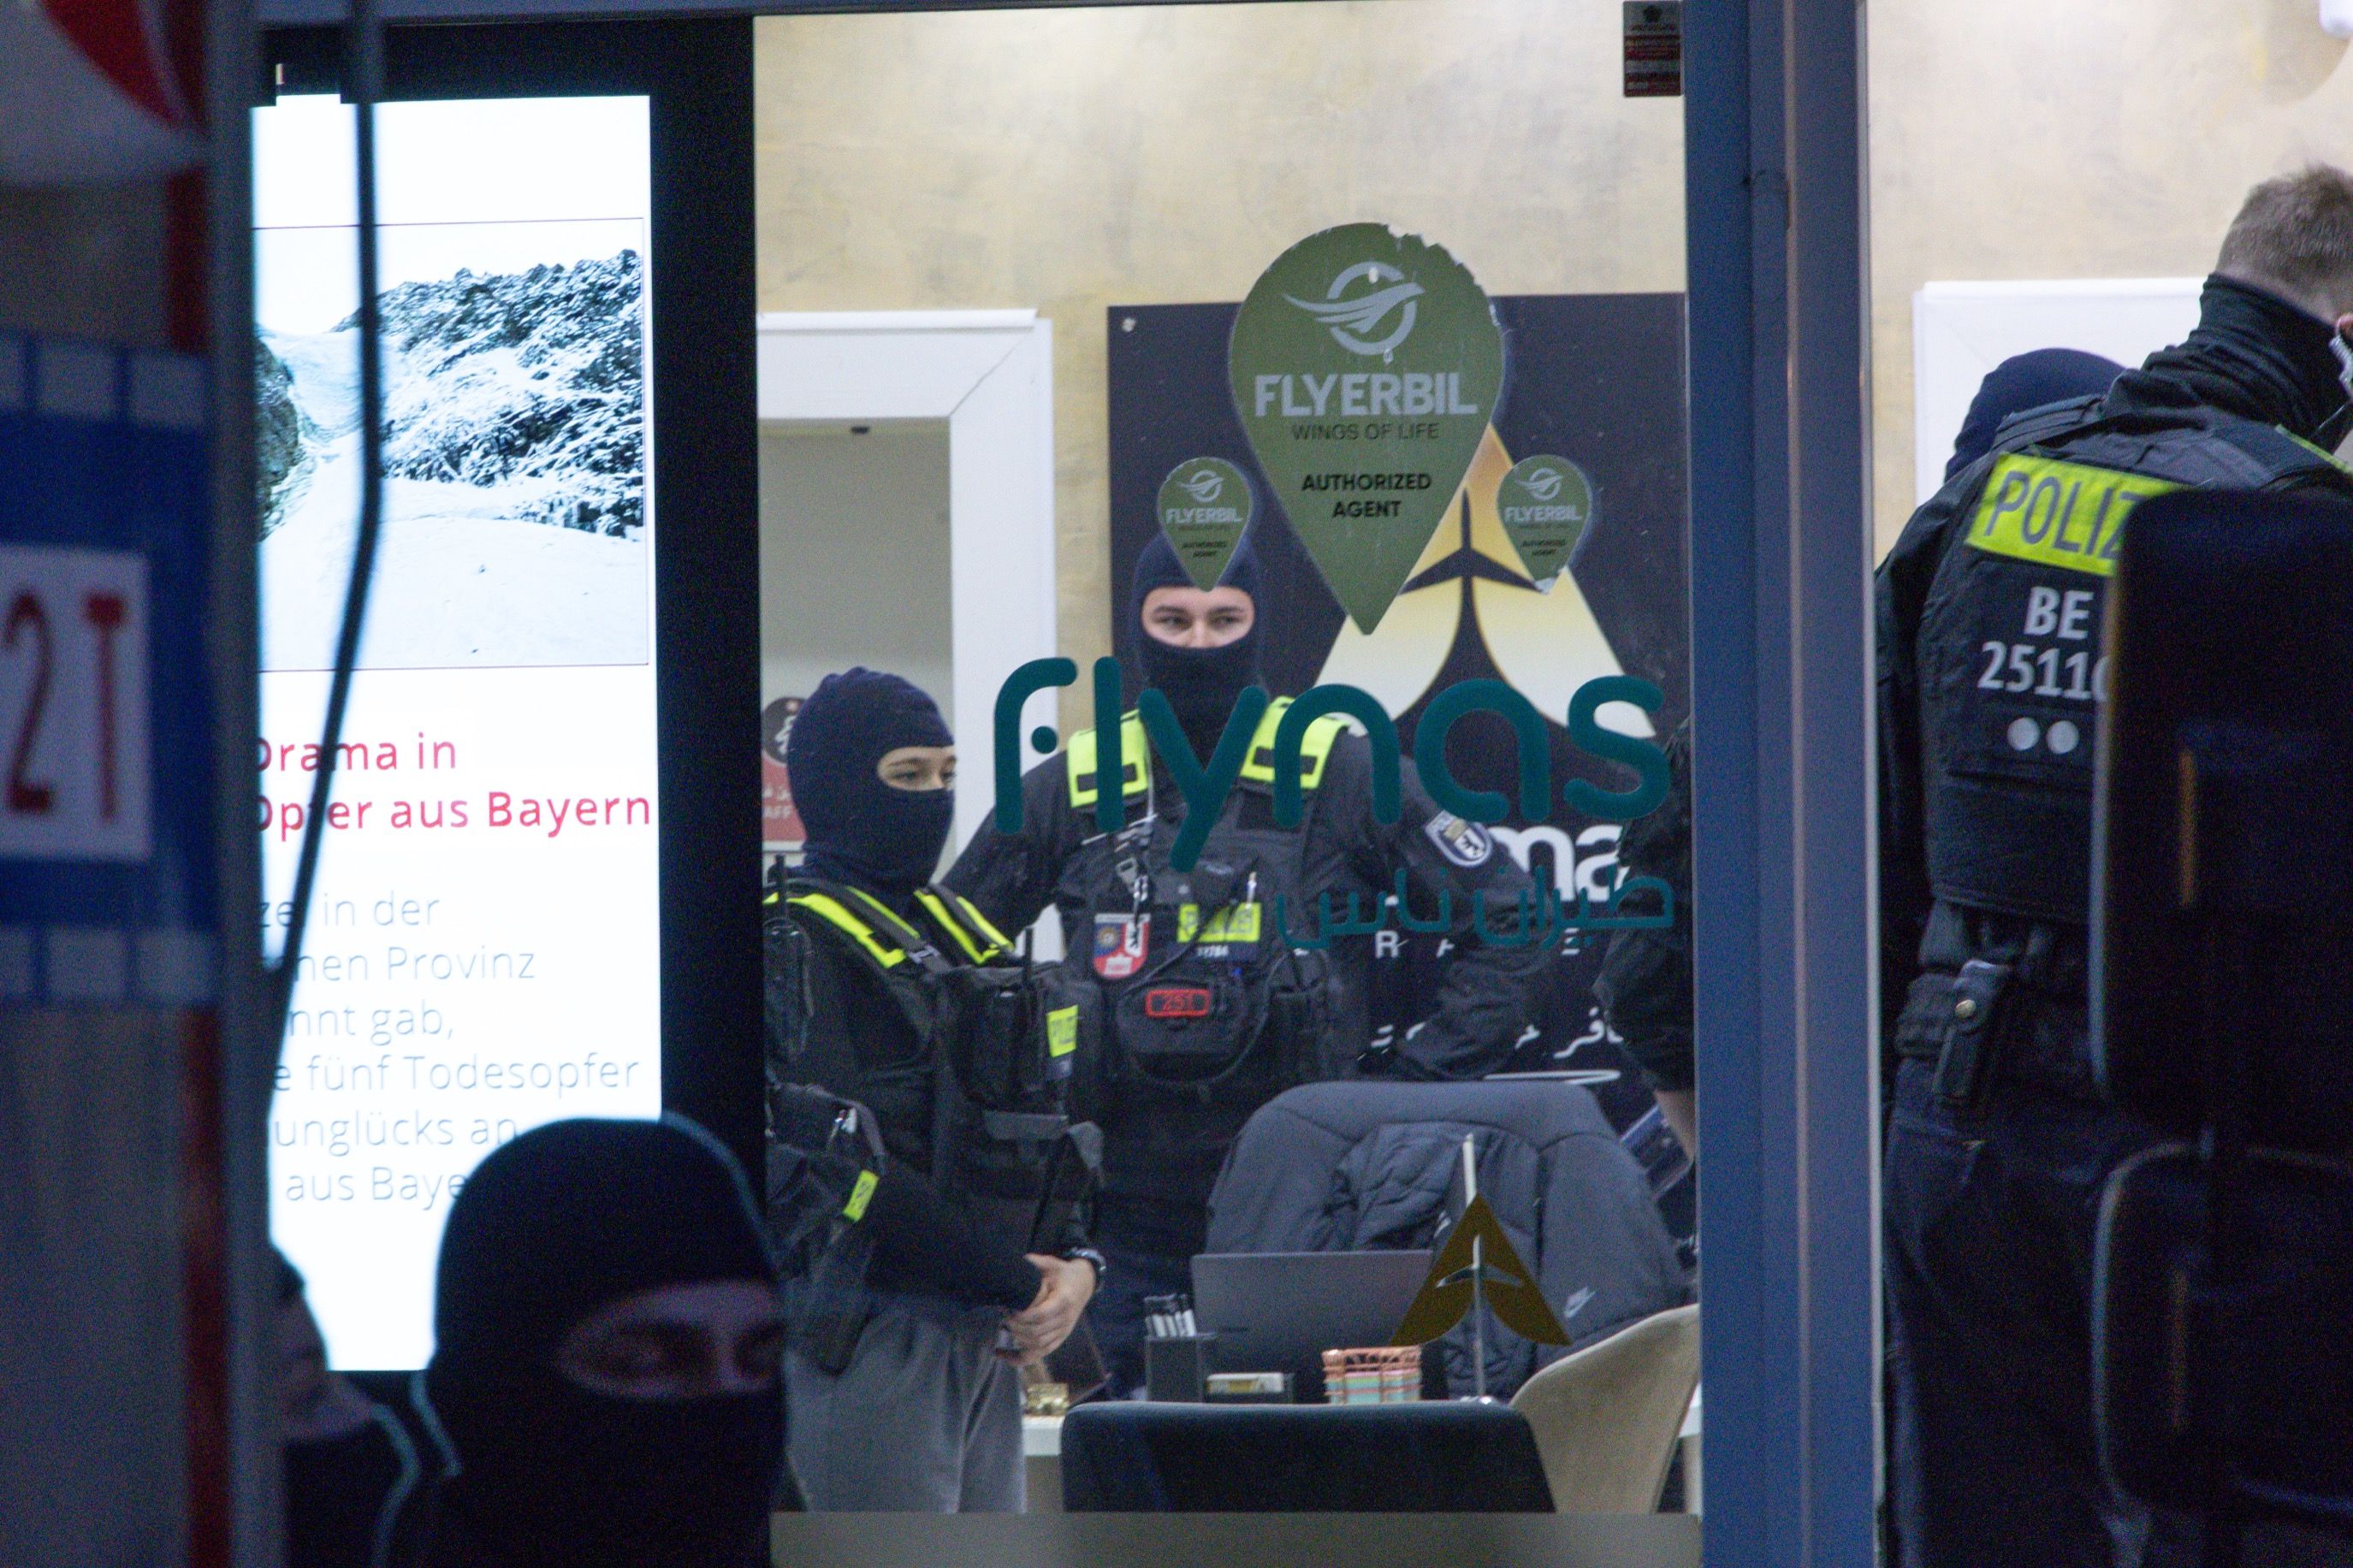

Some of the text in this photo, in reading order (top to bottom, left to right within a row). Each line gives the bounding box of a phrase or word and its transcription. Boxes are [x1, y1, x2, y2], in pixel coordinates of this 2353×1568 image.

[1254, 372, 1479, 417] FLYERBIL
[1291, 422, 1440, 441] WINGS OF LIFE
[1301, 472, 1432, 492] AUTHORIZED
[1332, 500, 1402, 518] AGENT
[2023, 585, 2095, 641] BE
[418, 731, 456, 770] in
[993, 655, 1671, 873] flynas
[389, 798, 470, 830] aus
[487, 791, 651, 838] Bayern
[323, 892, 356, 926] in
[373, 890, 441, 926] der
[387, 944, 536, 980] Provinz
[370, 998, 453, 1046] gab,
[307, 1054, 390, 1092] fünf
[403, 1051, 640, 1100] Todesopfer
[286, 1174, 354, 1202] aus
